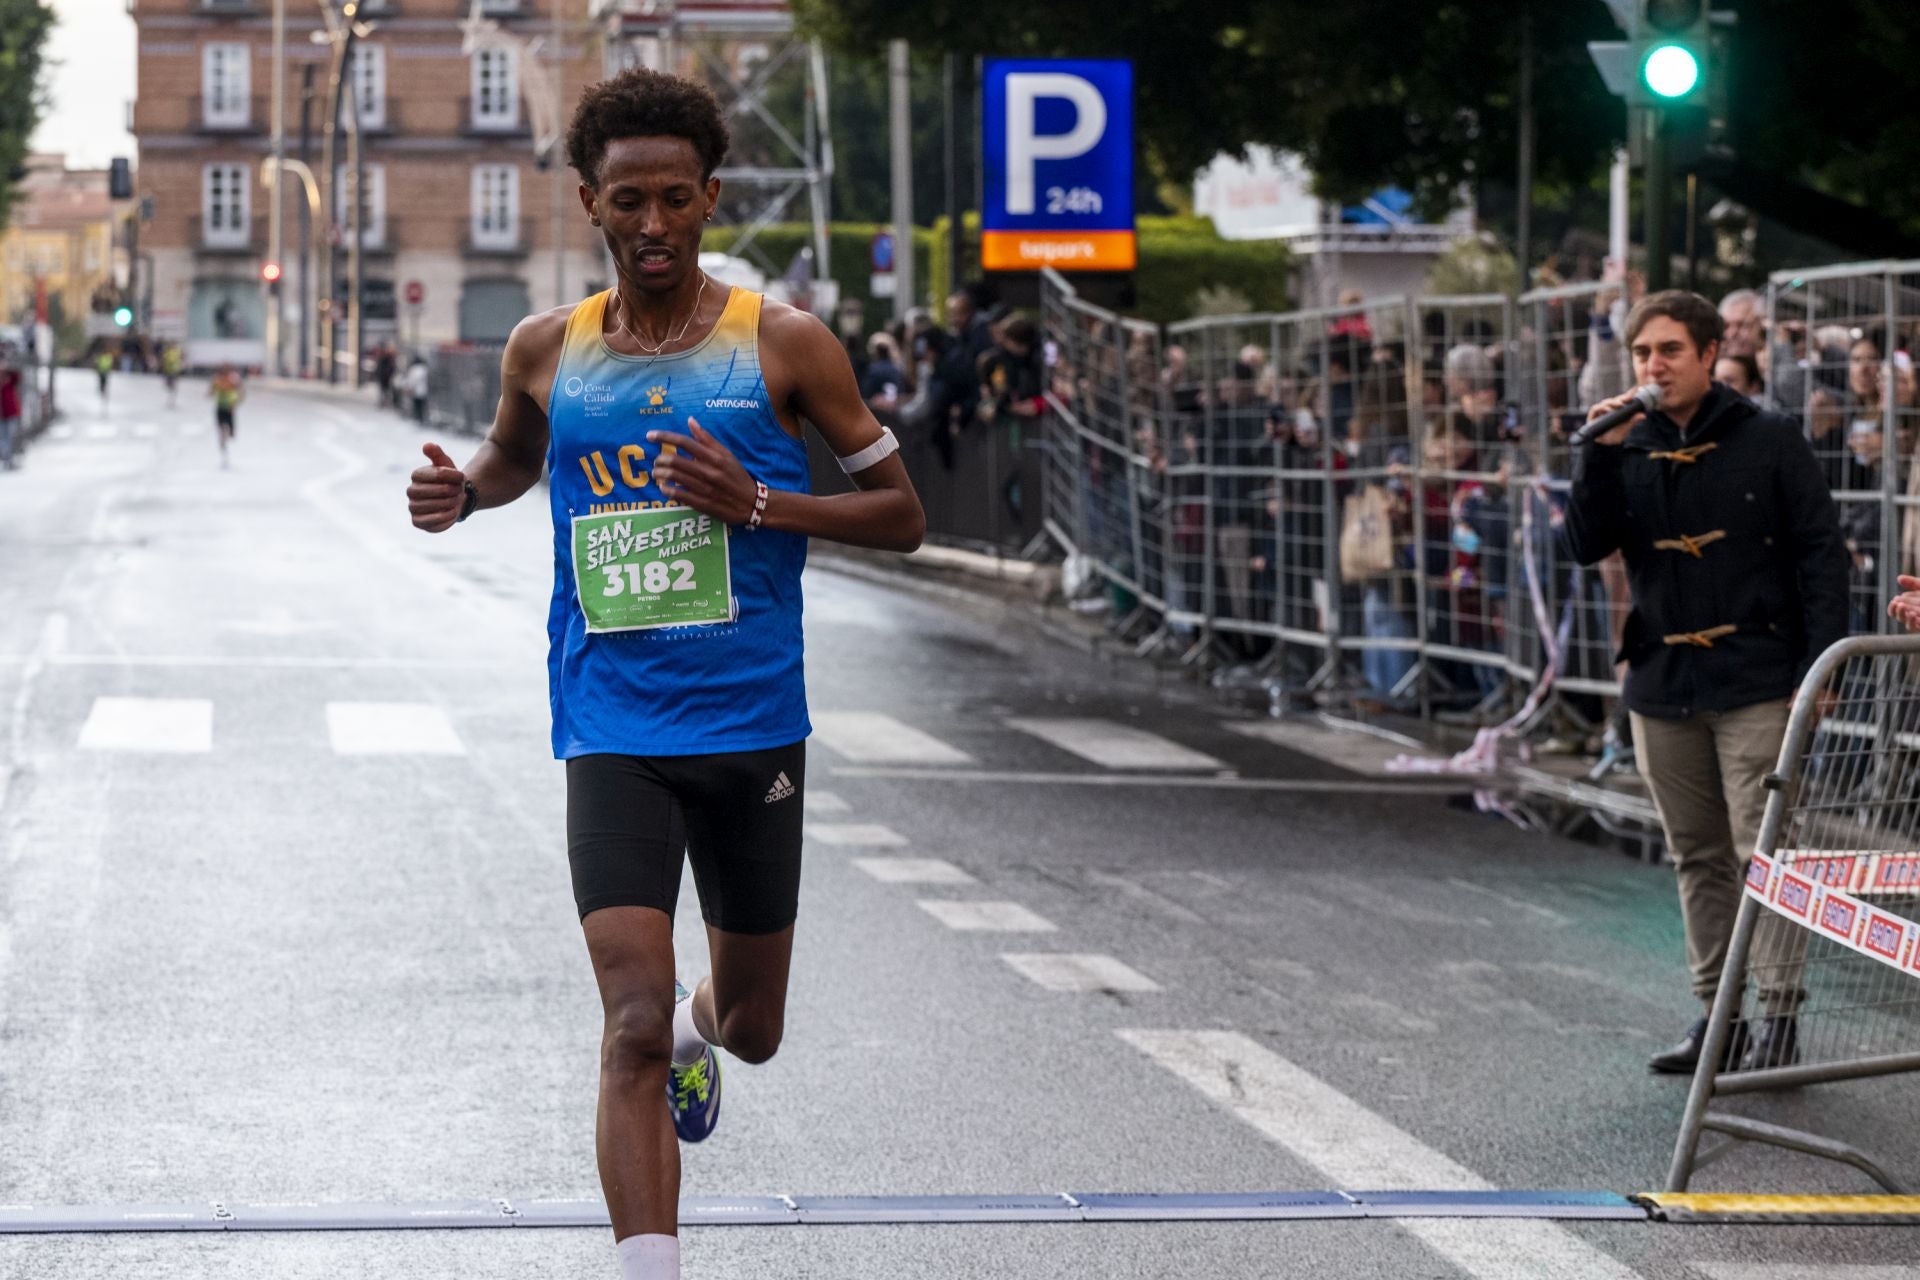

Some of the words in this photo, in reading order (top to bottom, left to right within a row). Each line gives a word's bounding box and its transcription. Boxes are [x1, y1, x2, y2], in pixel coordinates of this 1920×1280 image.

[1005, 72, 1108, 215] P
[1045, 186, 1103, 214] 24h
[584, 383, 612, 393] Costa
[639, 406, 673, 415] KELME
[705, 399, 760, 409] CARTAGENA
[586, 518, 633, 550] SAN
[586, 515, 712, 571] SILVESTRE
[658, 535, 712, 559] MURCIA
[602, 559, 697, 597] 3182
[764, 785, 796, 804] adidas
